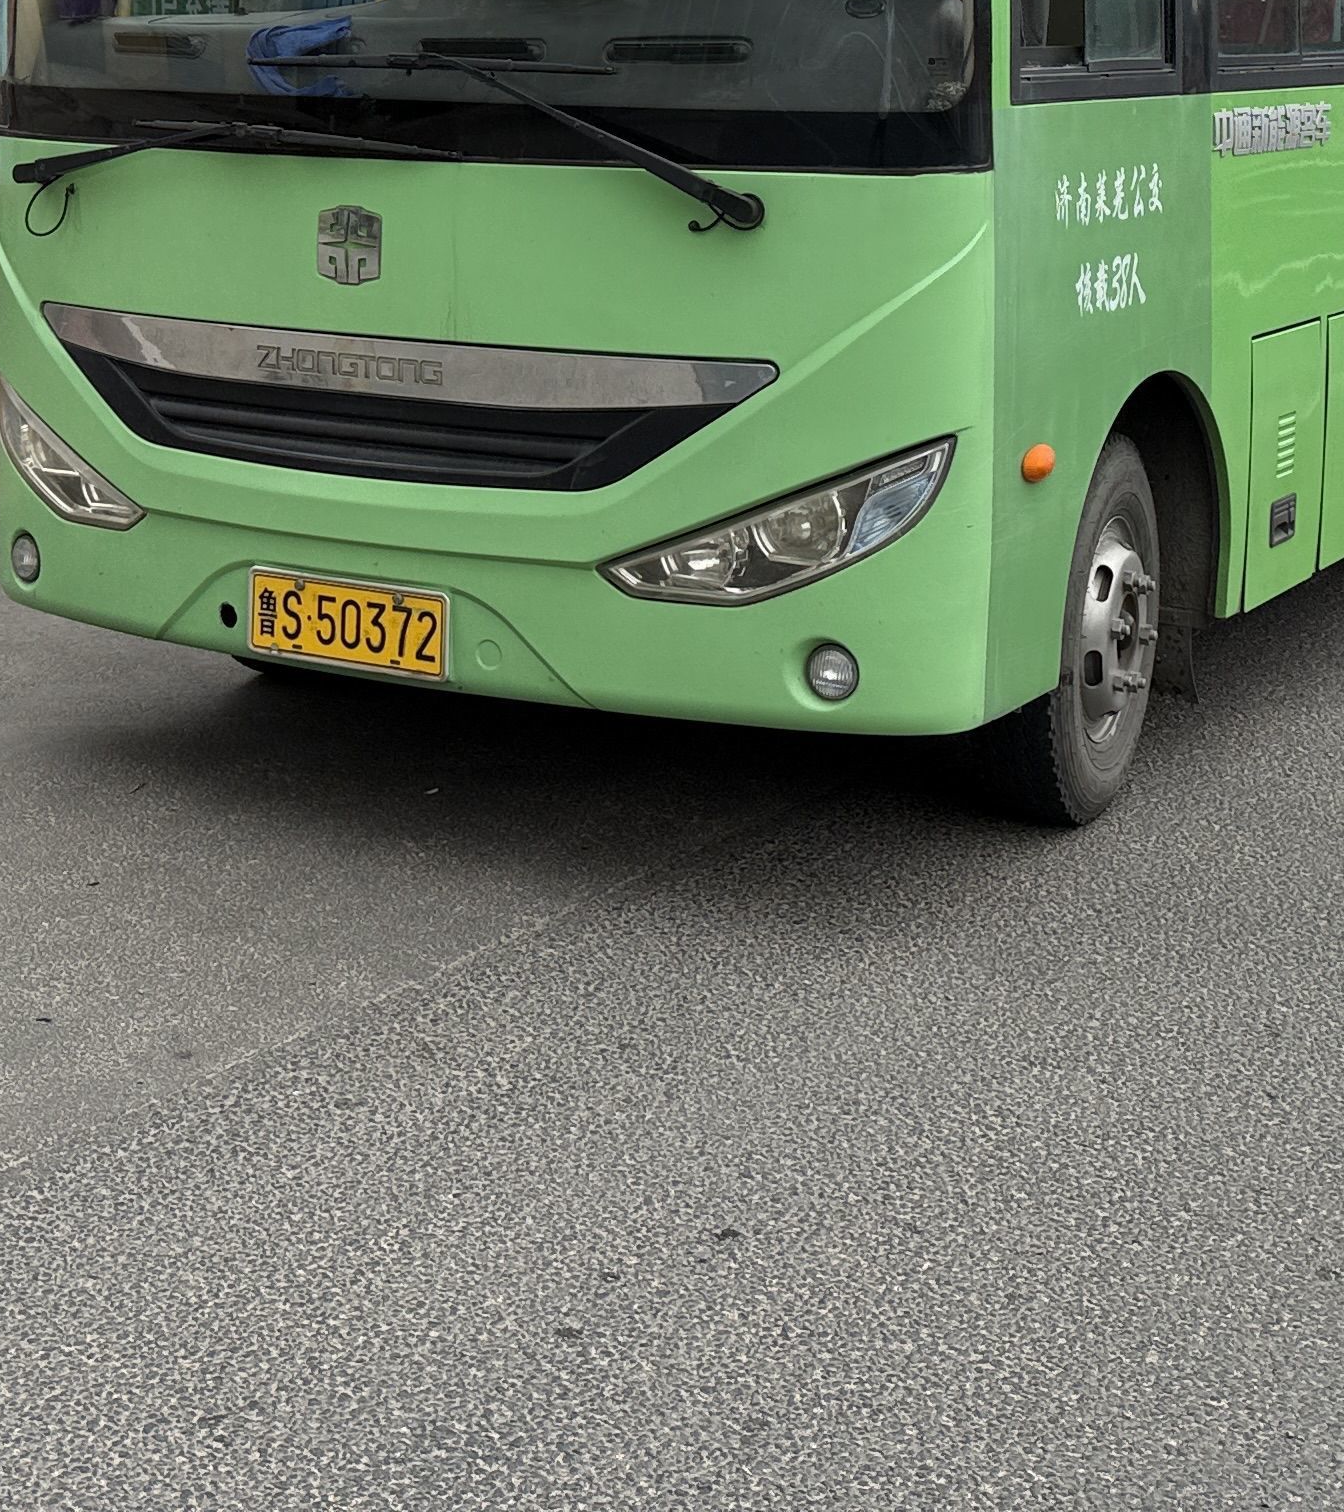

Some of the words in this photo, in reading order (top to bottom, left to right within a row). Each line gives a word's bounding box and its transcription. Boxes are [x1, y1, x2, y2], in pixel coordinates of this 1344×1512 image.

[1213, 101, 1332, 157] 中通新能源客车
[1055, 162, 1163, 229] 济南莱芜公交
[257, 345, 442, 385] ZHONGTONG
